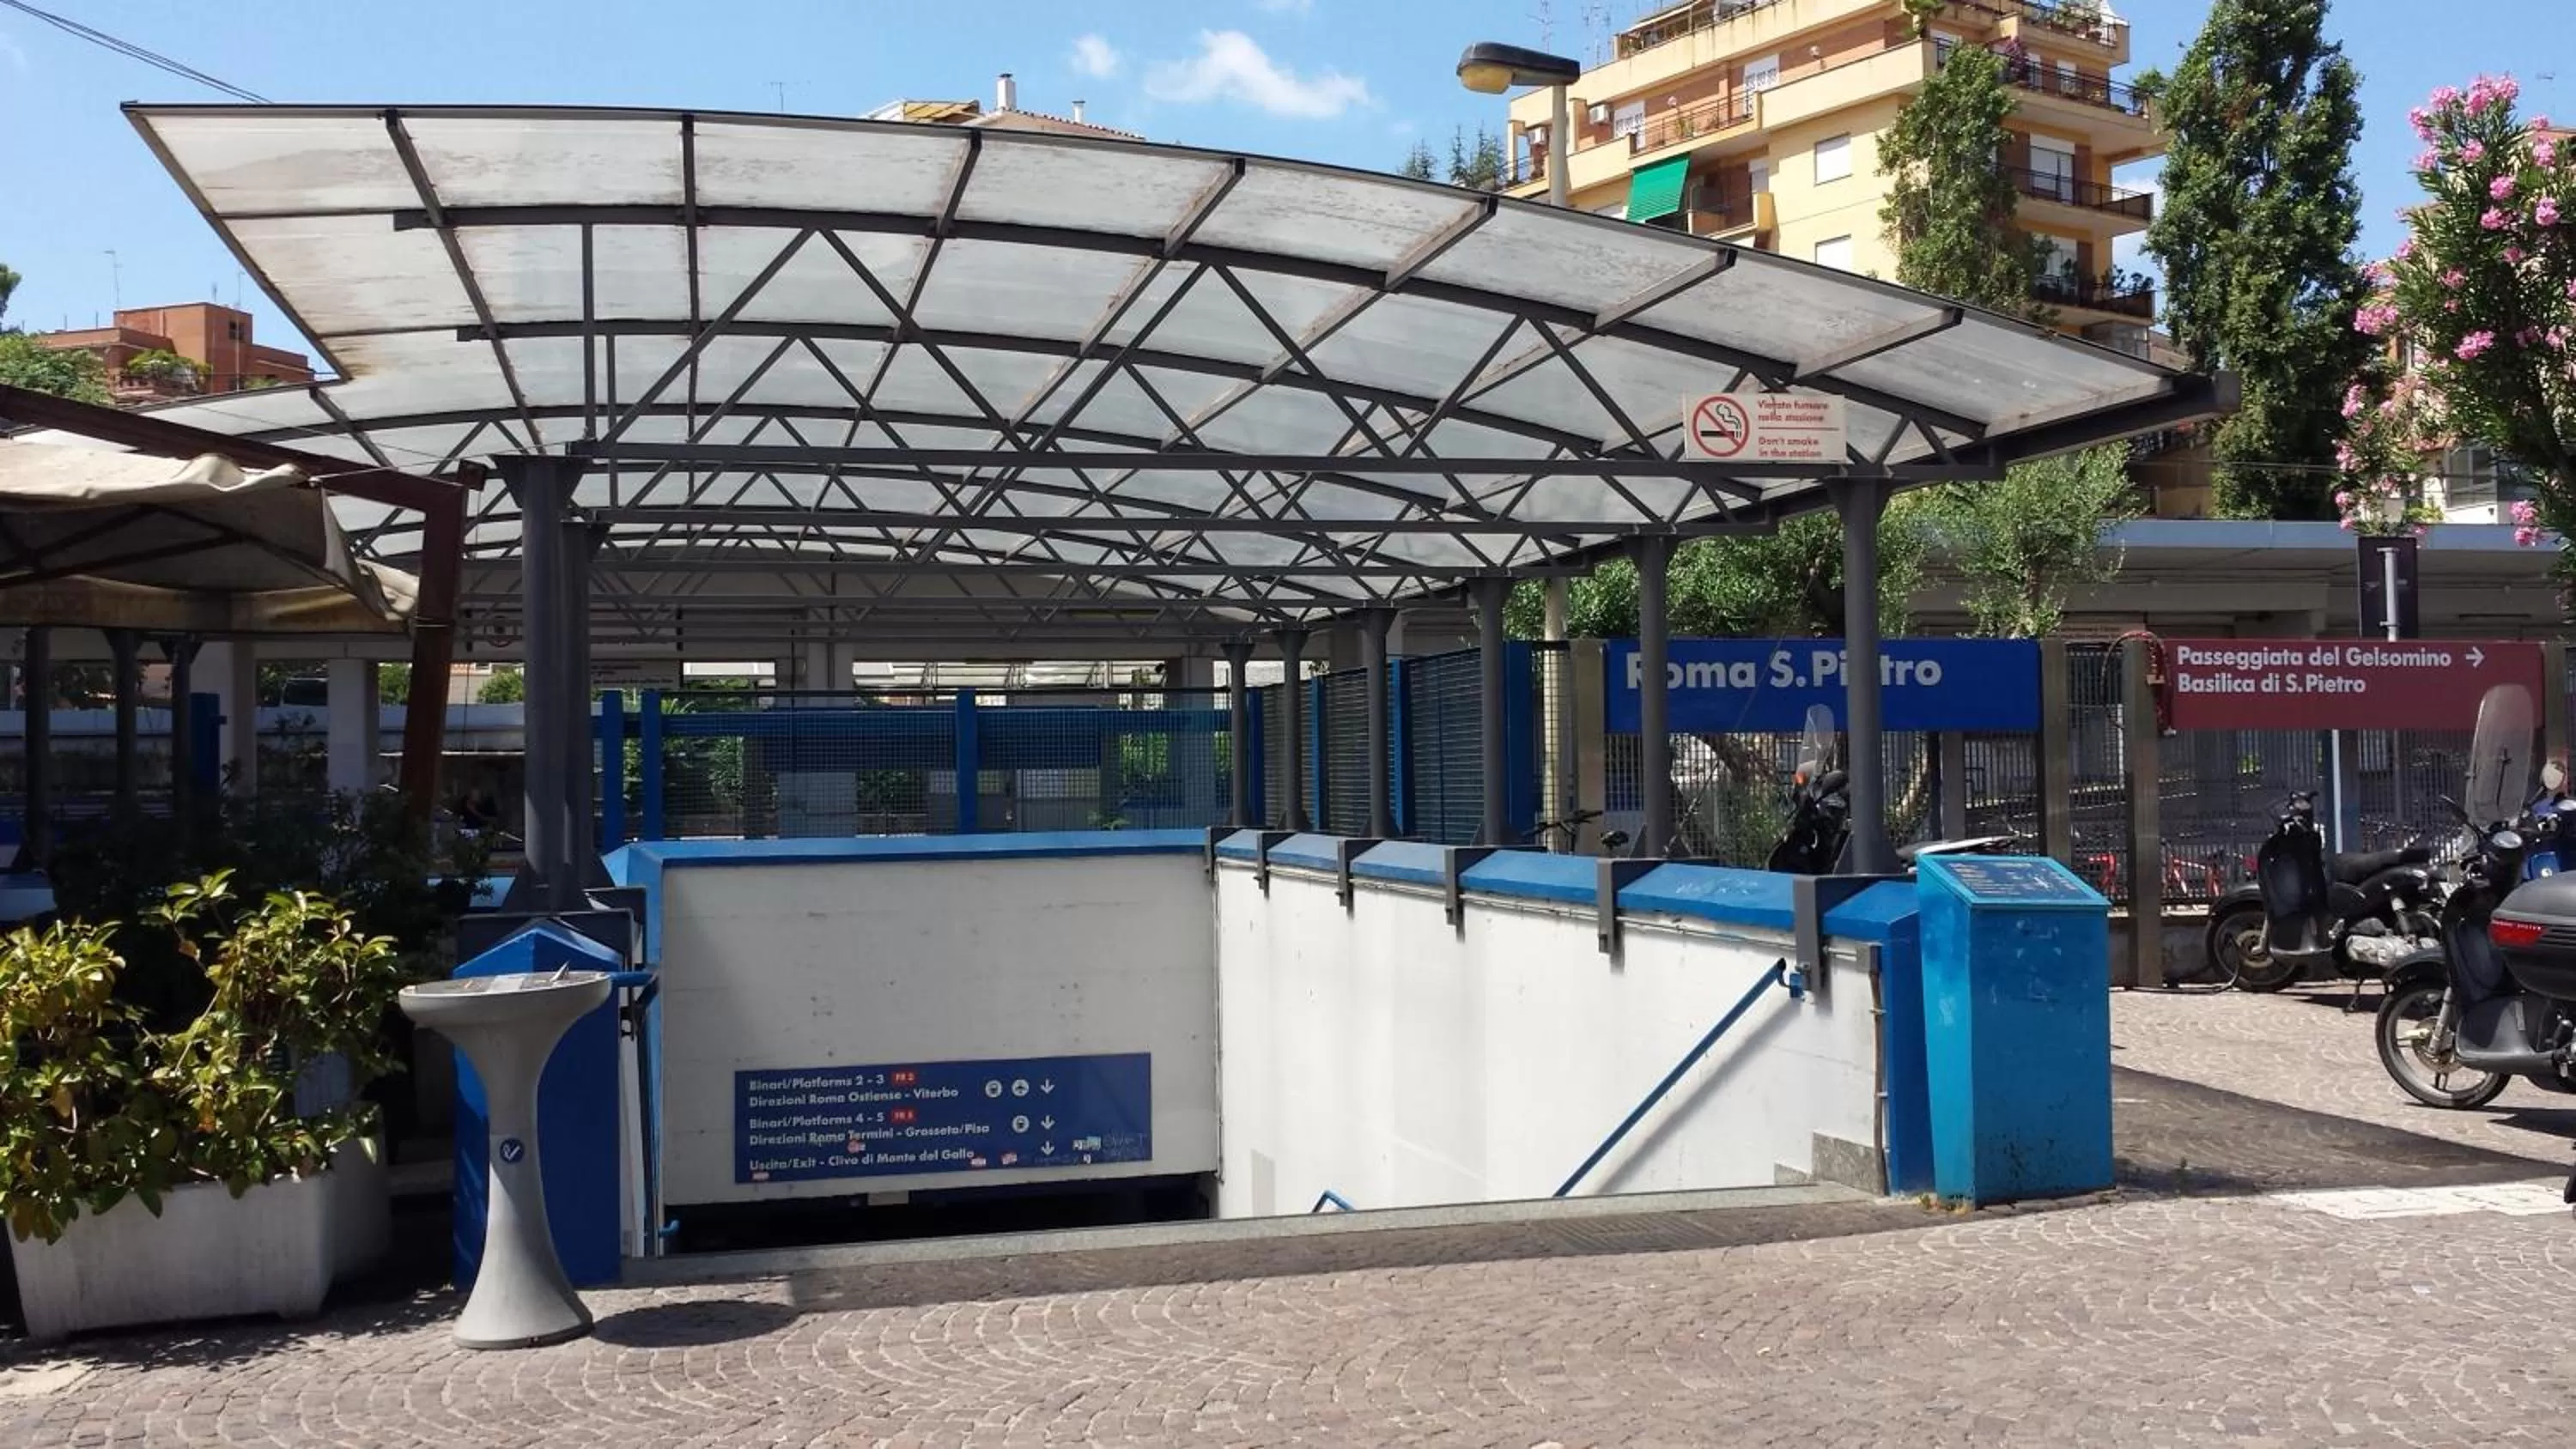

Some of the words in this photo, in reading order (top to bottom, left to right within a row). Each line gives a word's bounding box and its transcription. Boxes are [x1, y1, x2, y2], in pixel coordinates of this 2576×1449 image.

[2177, 646, 2303, 670] Passeggiata
[2309, 646, 2340, 666] del
[2346, 646, 2452, 667] Gelsomino
[2178, 673, 2256, 693] Basilica
[2261, 673, 2280, 693] di
[749, 1076, 853, 1091] Binari/Platforms
[855, 1076, 864, 1086] 2
[876, 1074, 884, 1084] 3
[749, 1094, 805, 1107] Direzioni
[809, 1094, 845, 1105] Roma
[848, 1089, 902, 1103] Ostiense
[913, 1087, 959, 1100] Viterbo
[749, 1115, 852, 1129] Binari/Platforms
[855, 1113, 865, 1124] 4
[877, 1112, 884, 1122] 5
[749, 1131, 805, 1145] Direzioni
[809, 1131, 845, 1143] Roma
[848, 1126, 894, 1140] Termini
[749, 1157, 816, 1171] Uscita/Exit
[828, 1155, 860, 1167] Clivo
[861, 1153, 873, 1165] di
[877, 1152, 916, 1164] Monte
[919, 1149, 939, 1161] del
[942, 1148, 975, 1161] Gallo
